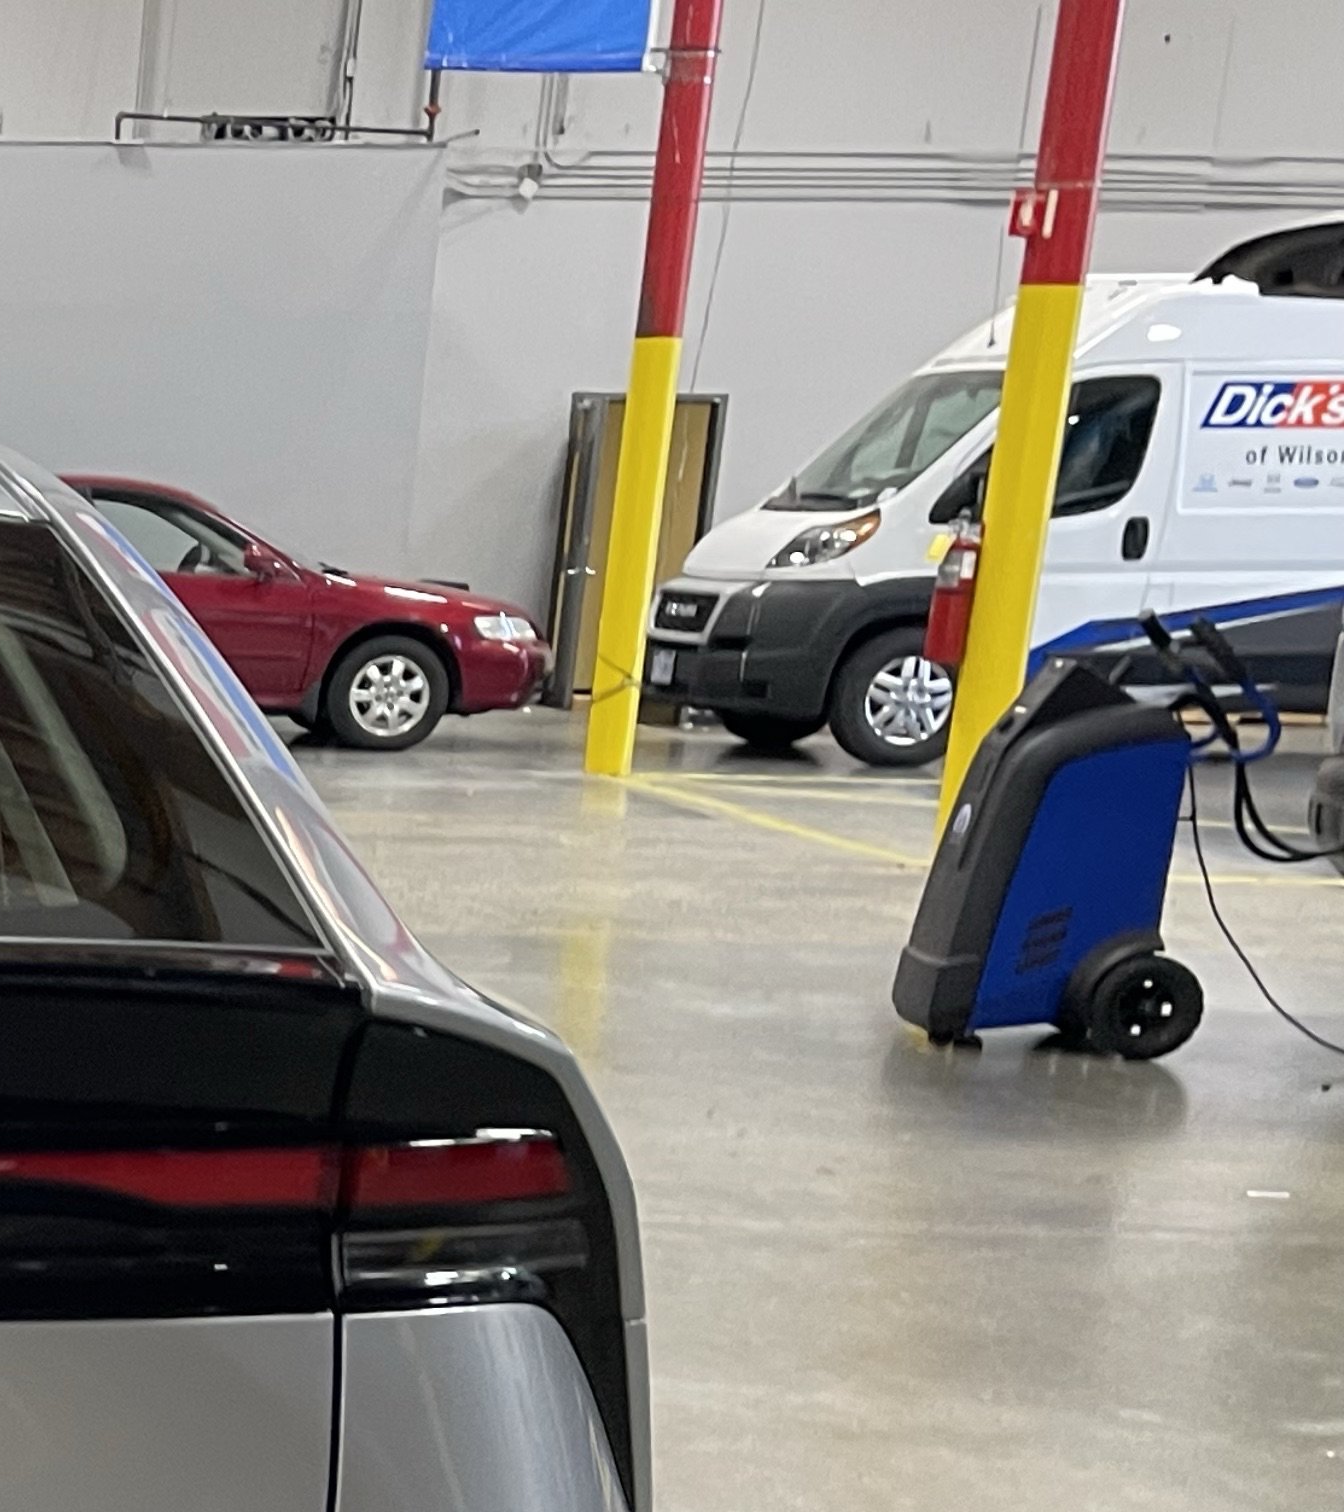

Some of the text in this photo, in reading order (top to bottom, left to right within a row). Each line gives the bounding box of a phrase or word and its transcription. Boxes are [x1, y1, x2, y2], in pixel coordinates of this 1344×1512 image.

[1209, 384, 1344, 425] Dick's
[1246, 445, 1344, 464] of Wilso
